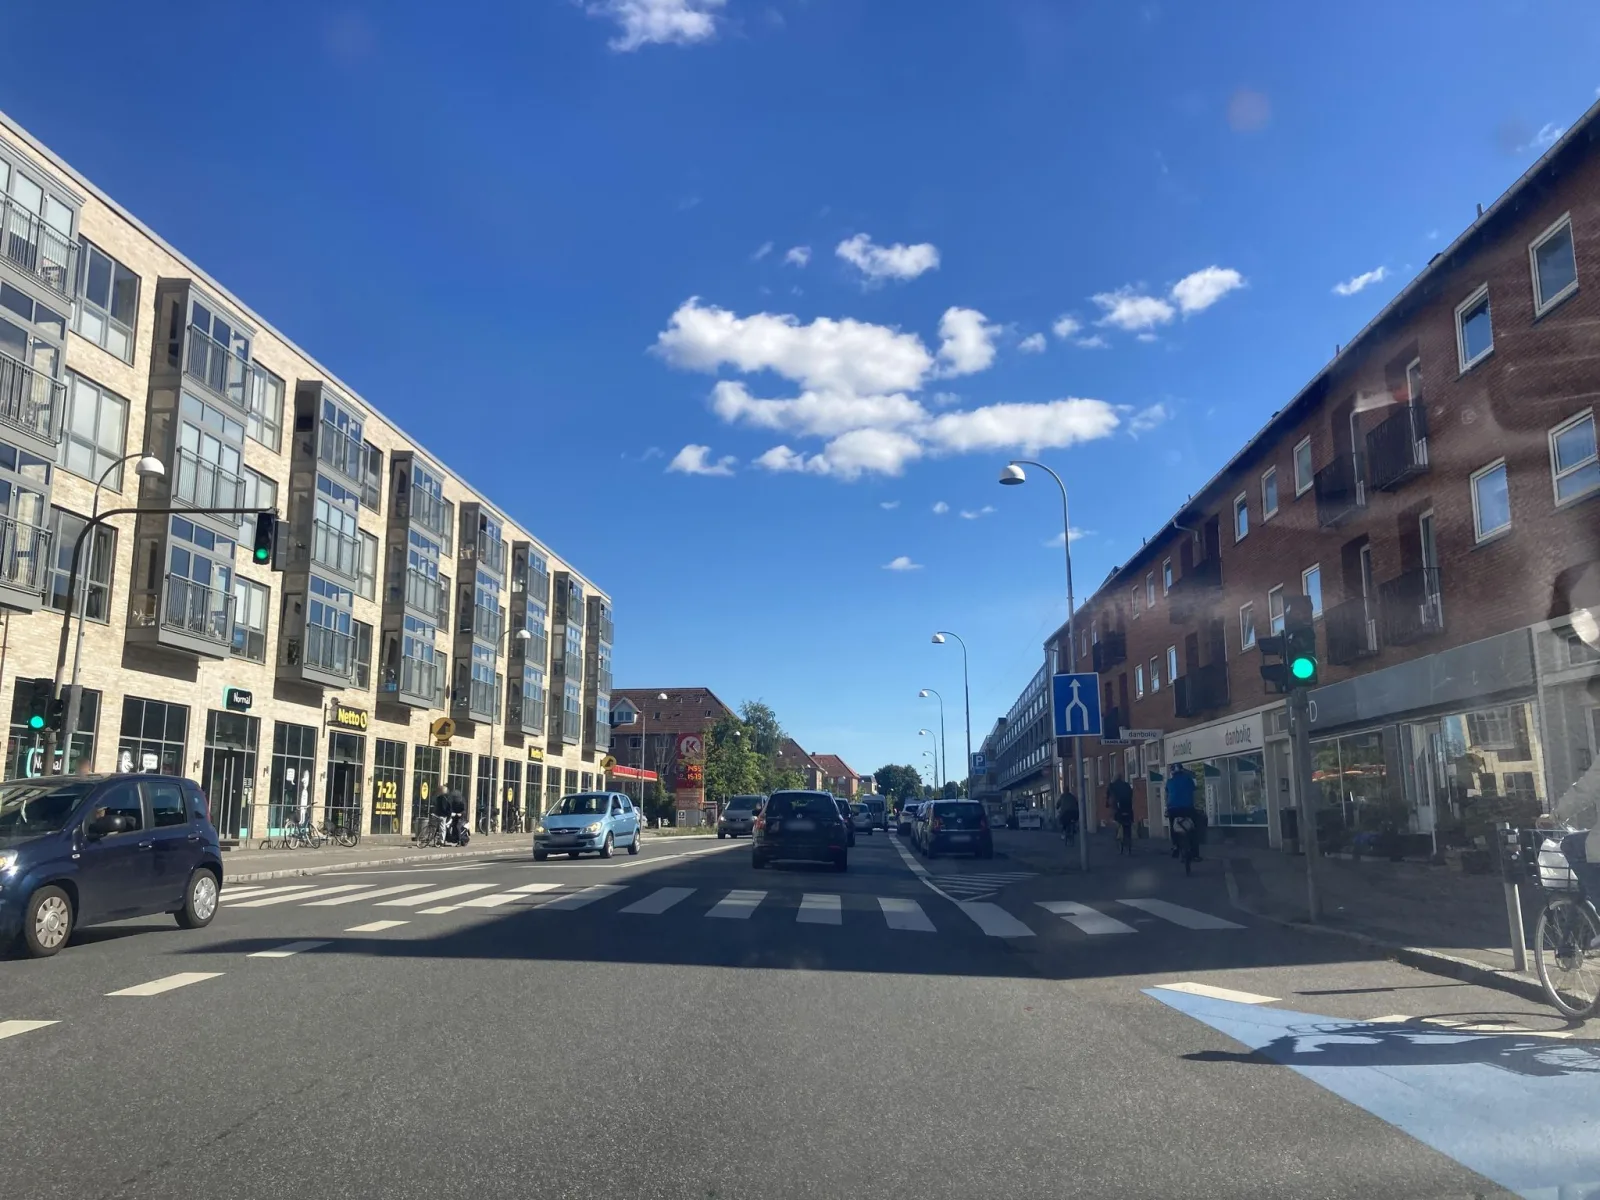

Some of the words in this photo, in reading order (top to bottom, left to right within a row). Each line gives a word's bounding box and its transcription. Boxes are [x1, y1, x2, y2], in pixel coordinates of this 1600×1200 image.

[233, 691, 251, 704] Normal
[338, 707, 360, 726] Netto
[976, 755, 984, 766] P
[377, 781, 397, 799] 7-22
